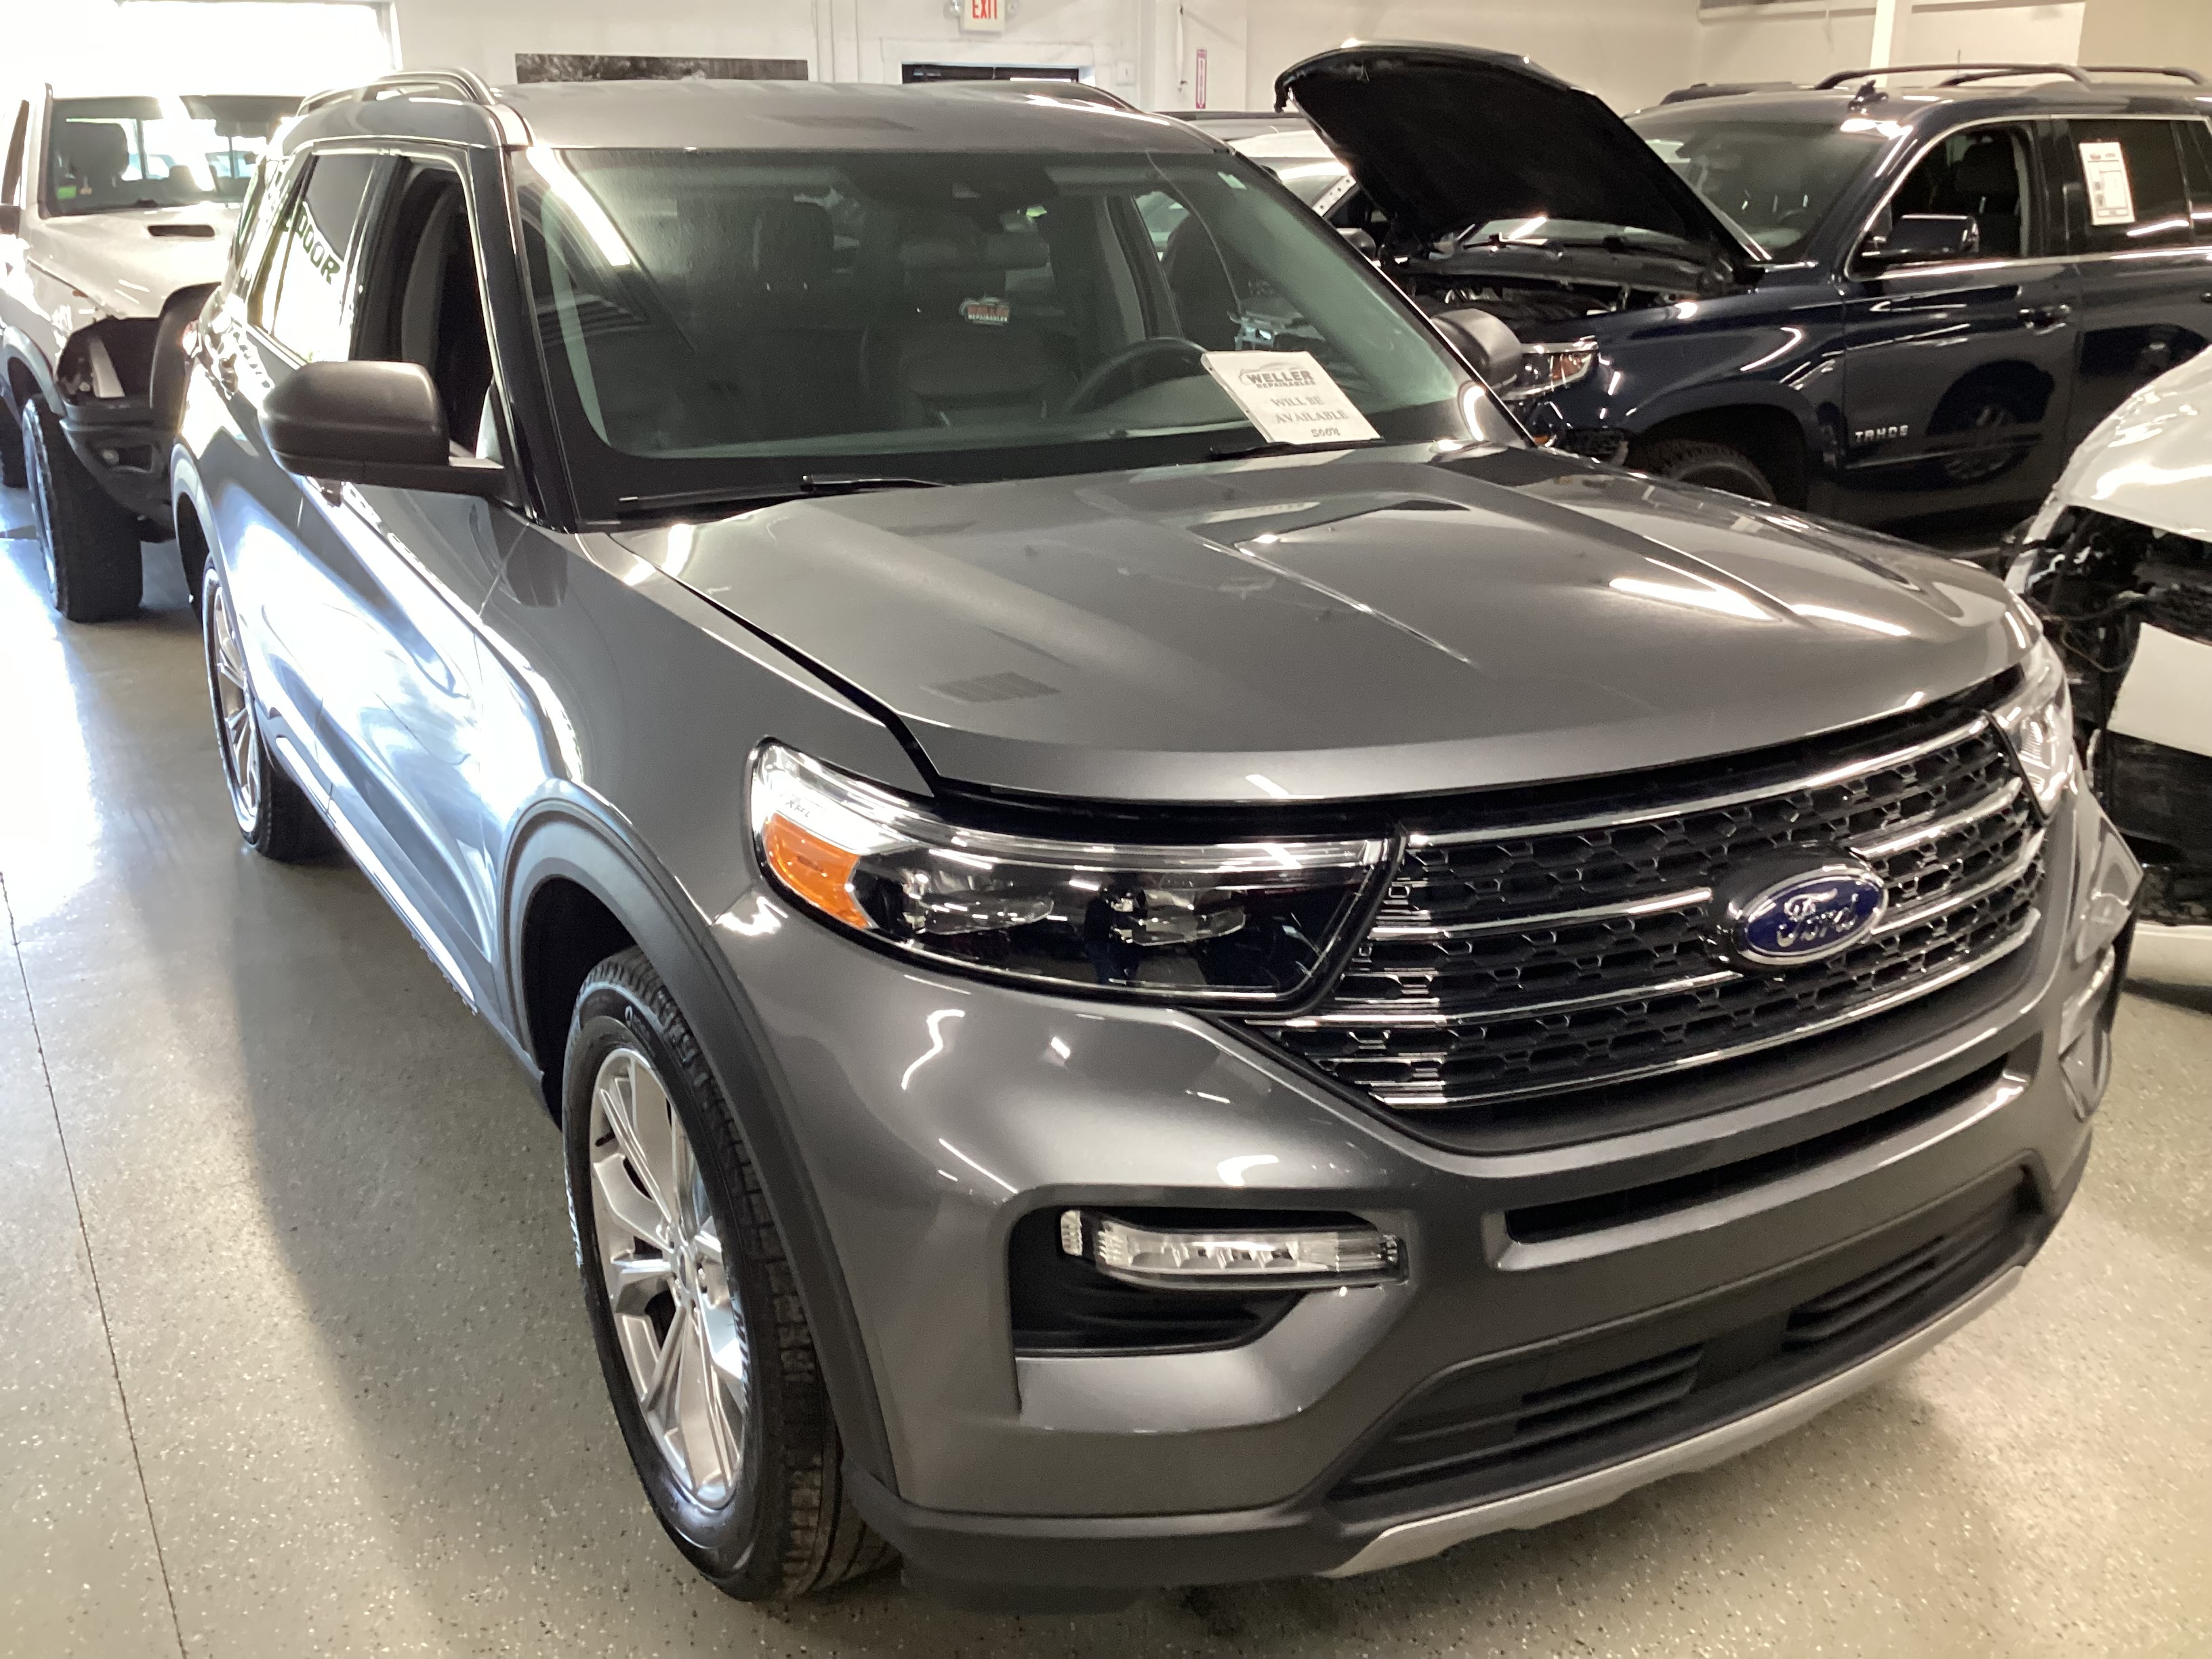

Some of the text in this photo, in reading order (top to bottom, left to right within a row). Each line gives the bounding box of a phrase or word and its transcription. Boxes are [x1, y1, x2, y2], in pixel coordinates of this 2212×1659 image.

[1246, 371, 1313, 384] WELLER
[1270, 396, 1325, 407] WILL BE
[1275, 409, 1349, 424] AVAILABLE
[1776, 886, 1860, 948] Ford
